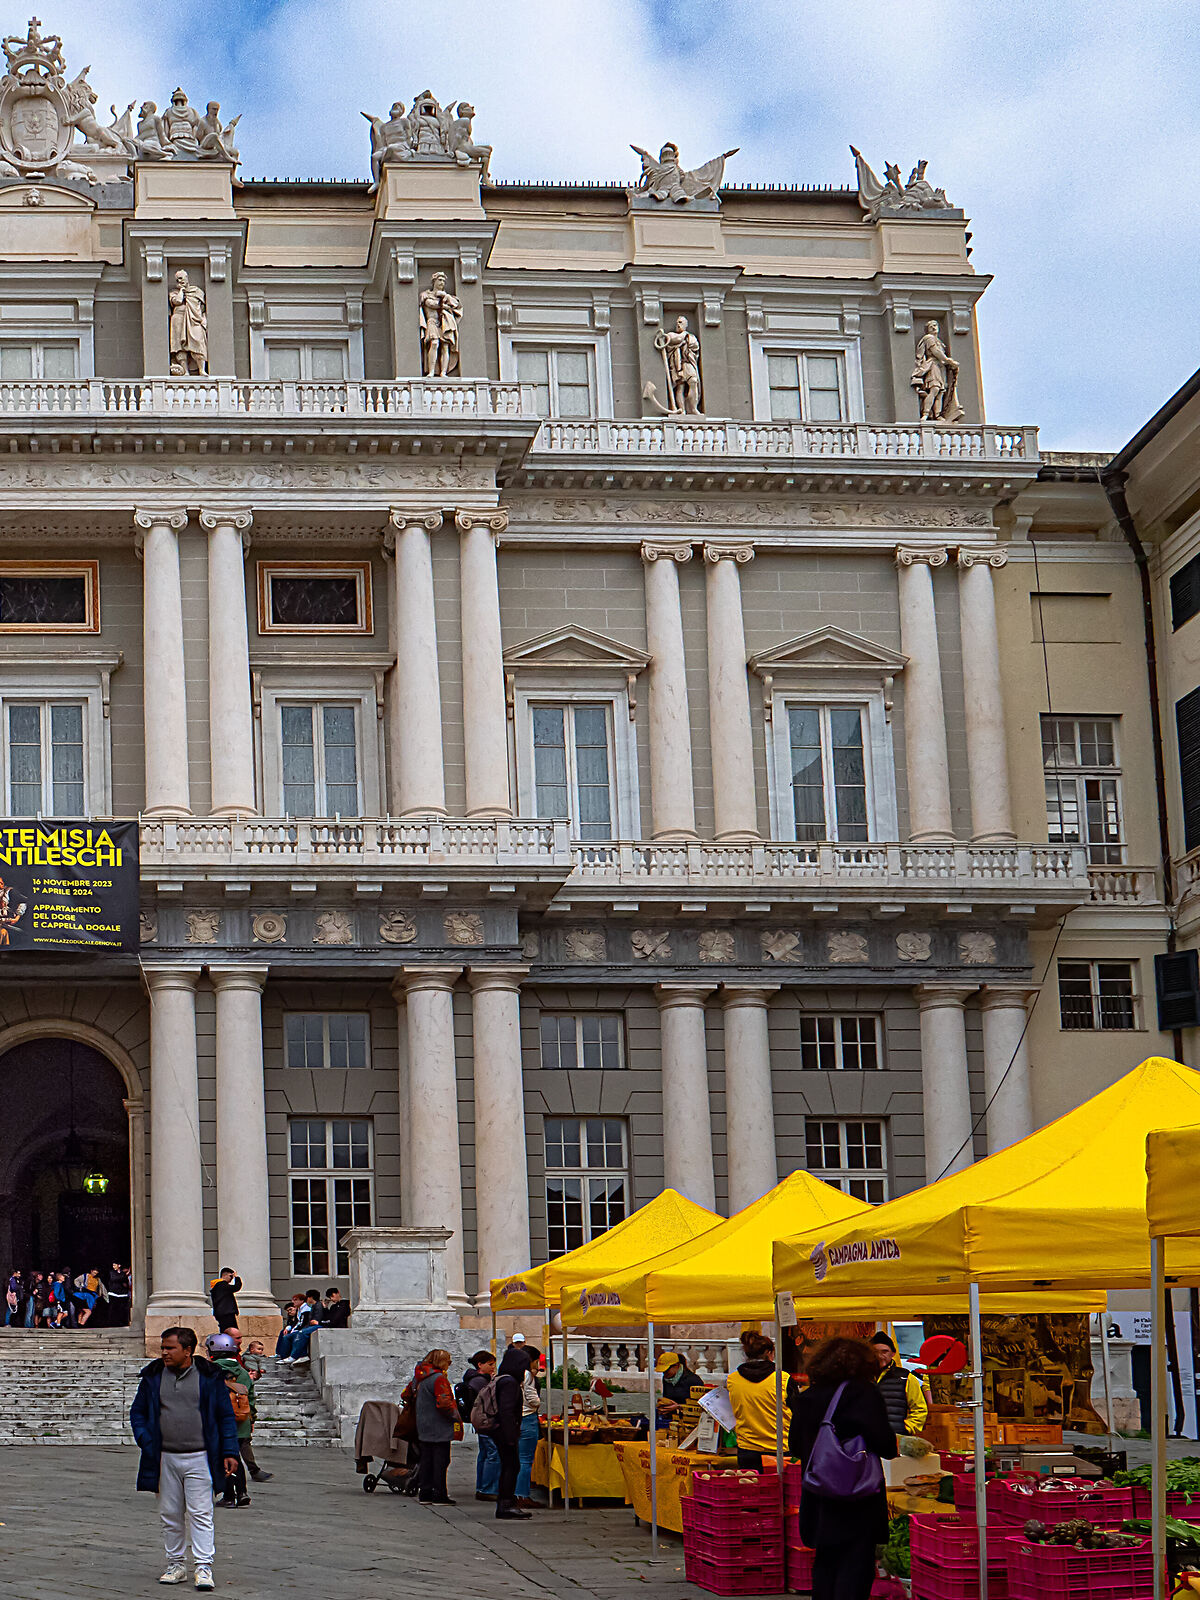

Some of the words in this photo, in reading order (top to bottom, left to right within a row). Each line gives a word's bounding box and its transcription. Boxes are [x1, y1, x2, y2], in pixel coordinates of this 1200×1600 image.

[32, 878, 42, 886] 16
[43, 878, 91, 887] NOVEMBRE
[92, 880, 113, 888] 2023
[42, 887, 71, 896] APRILE
[72, 888, 94, 896] 2024
[33, 904, 102, 914] APPARTAMENTO
[33, 912, 50, 920] DEL
[51, 913, 77, 922] DOGE
[40, 921, 85, 931] CAPPELLA
[85, 923, 121, 932] DOGALE
[828, 1241, 868, 1267] CAMPAGNA
[869, 1238, 901, 1260] AMICA
